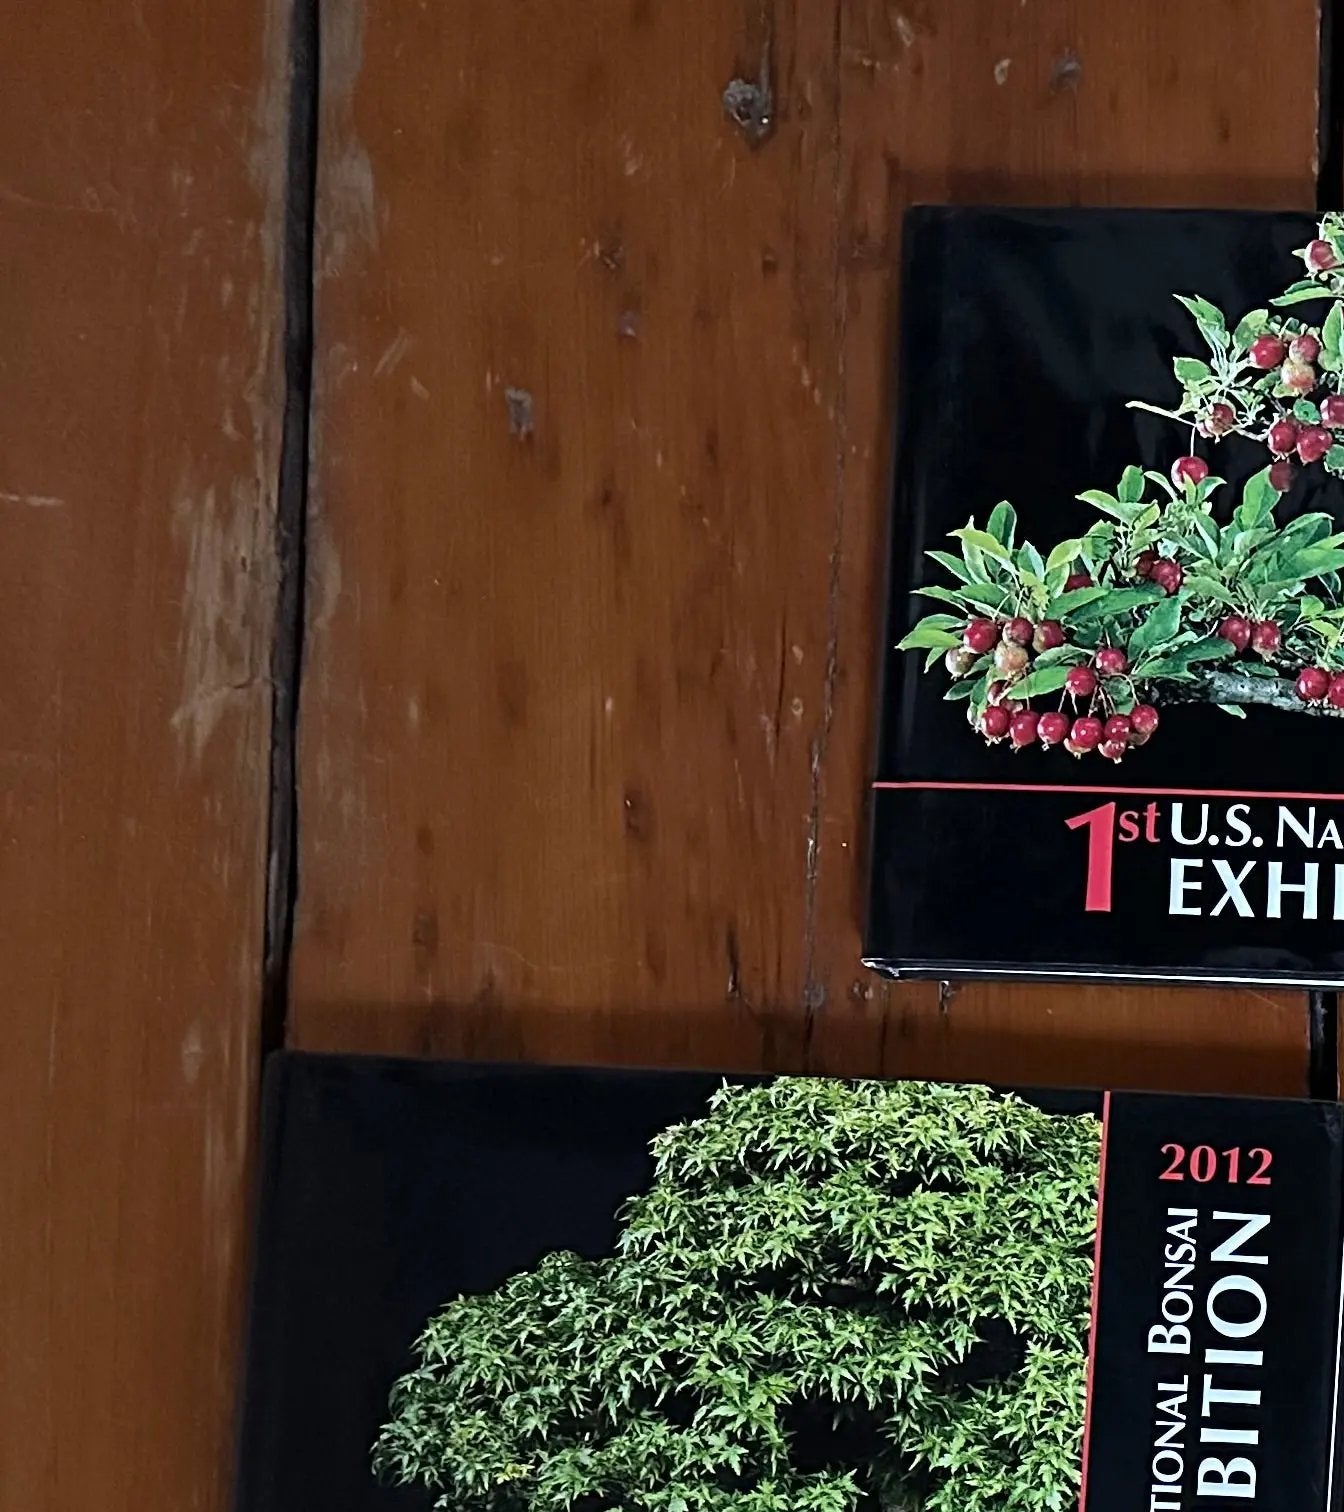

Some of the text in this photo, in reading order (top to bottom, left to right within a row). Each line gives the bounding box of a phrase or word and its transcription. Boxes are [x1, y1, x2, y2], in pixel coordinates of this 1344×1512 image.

[1065, 801, 1159, 913] 1st
[1168, 802, 1264, 848] U.S.
[1161, 1143, 1273, 1185] 2012
[1147, 1207, 1199, 1355] BONSAI
